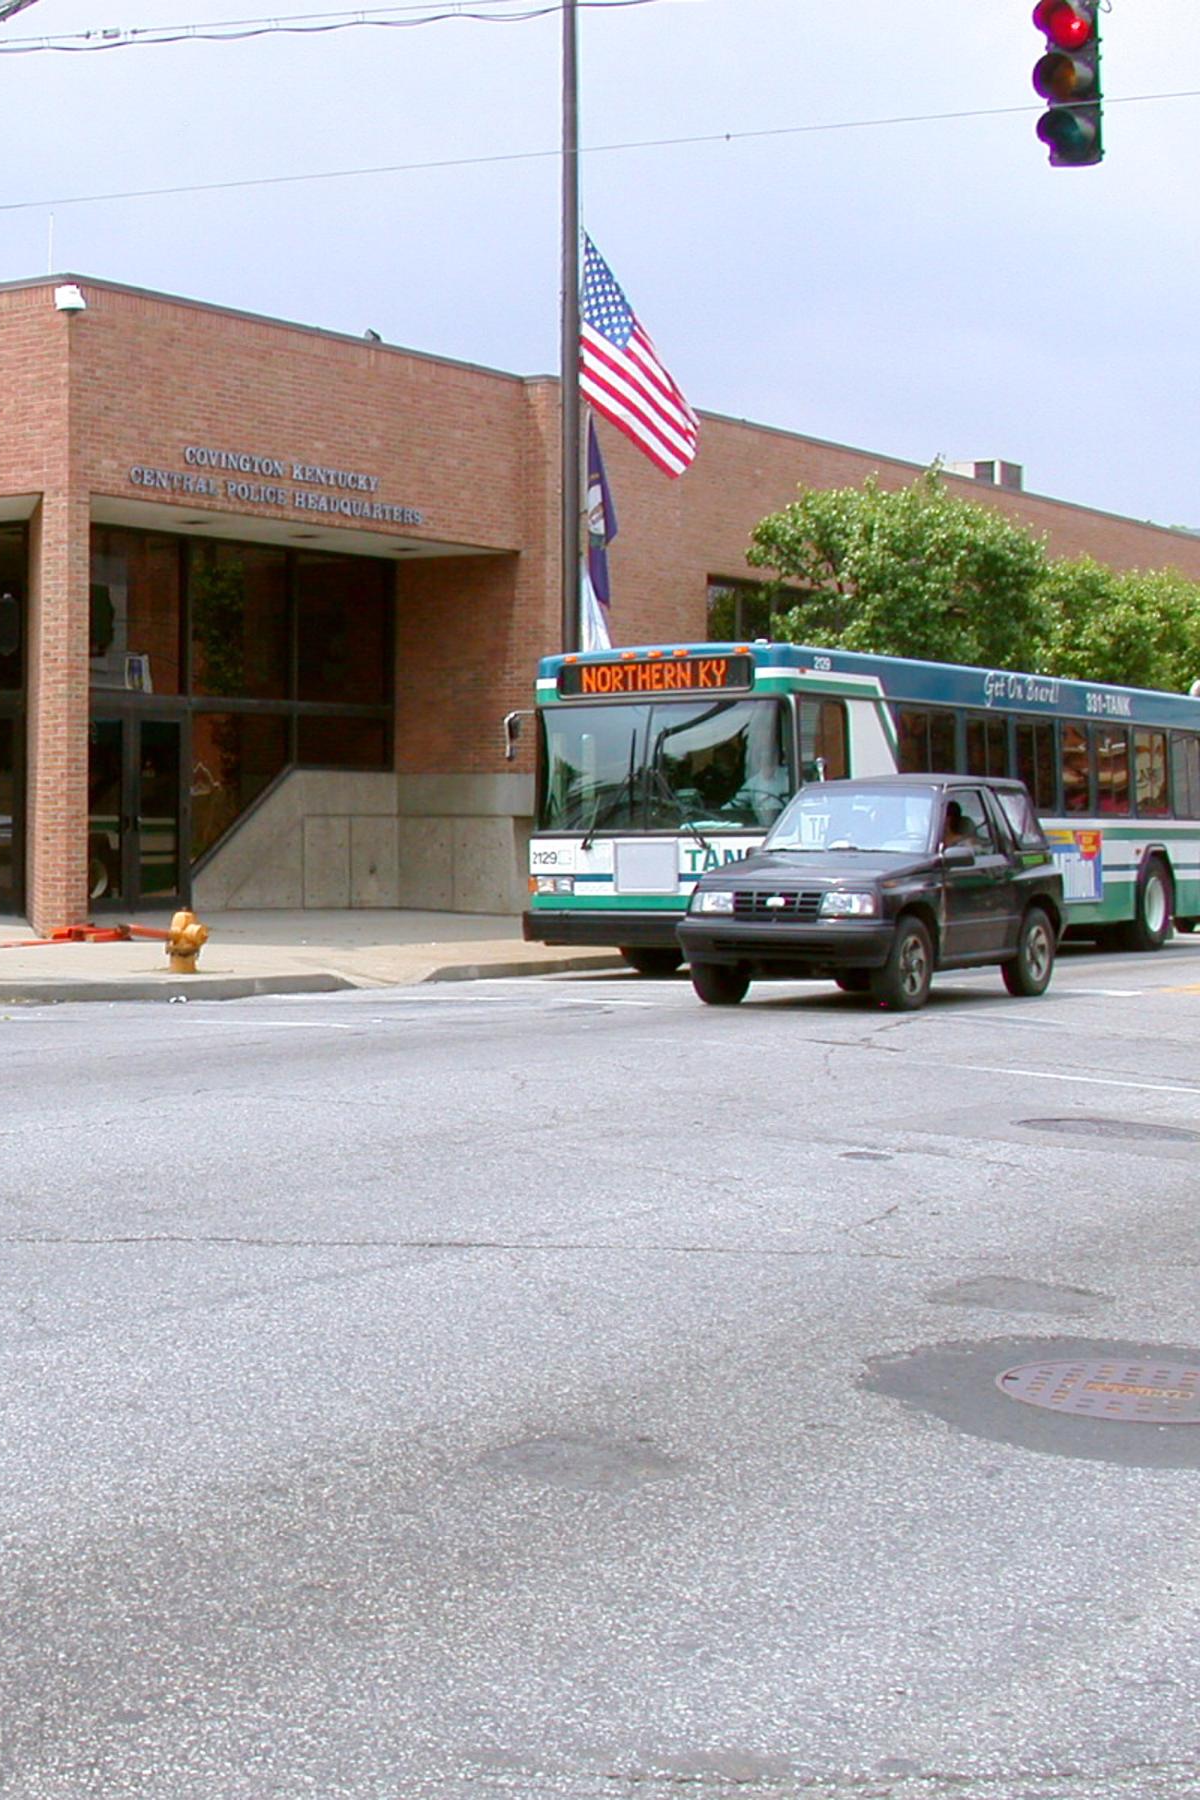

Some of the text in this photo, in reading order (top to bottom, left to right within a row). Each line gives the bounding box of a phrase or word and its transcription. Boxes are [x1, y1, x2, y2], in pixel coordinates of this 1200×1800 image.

[184, 447, 379, 492] COVINGTON KENTUCKY
[130, 466, 422, 525] CENTRAL POLICE HEADQUARTERS
[581, 659, 726, 693] NORTHERN KY
[984, 671, 1005, 708] Get
[1008, 675, 1023, 699] On
[532, 851, 558, 865] 2129
[684, 848, 745, 872] TAN
